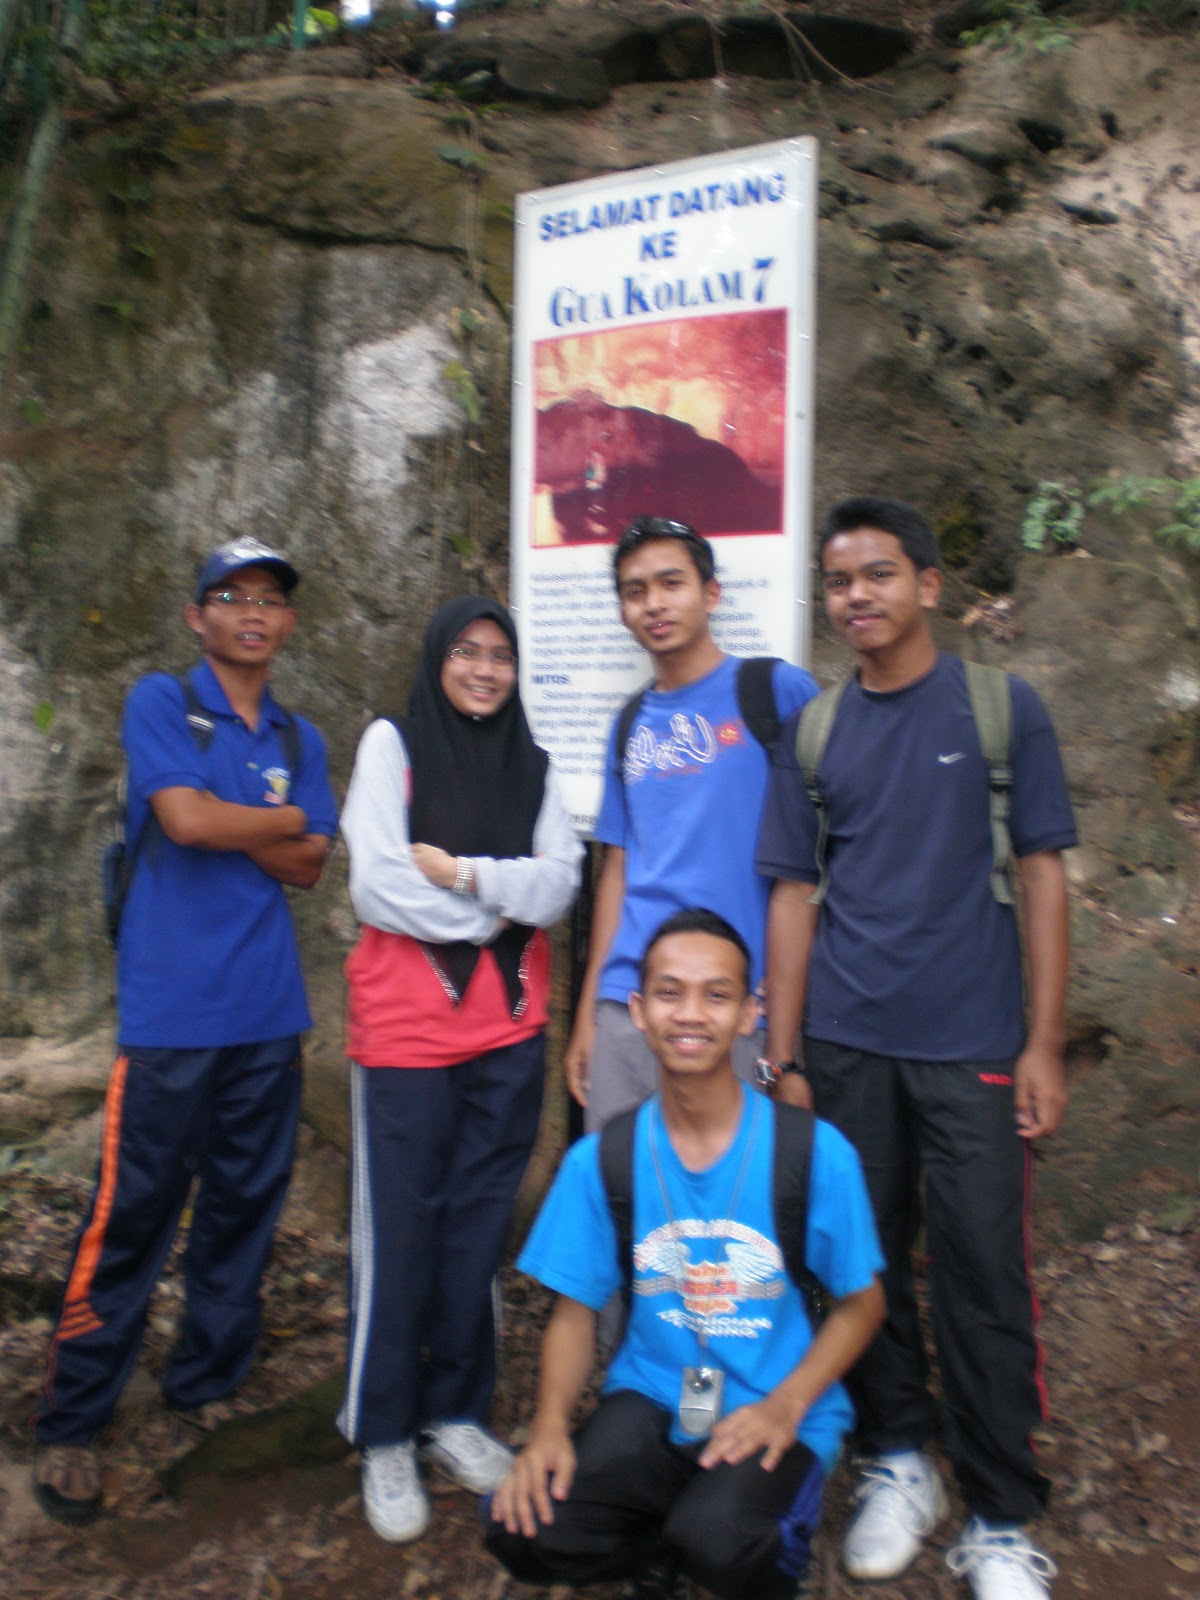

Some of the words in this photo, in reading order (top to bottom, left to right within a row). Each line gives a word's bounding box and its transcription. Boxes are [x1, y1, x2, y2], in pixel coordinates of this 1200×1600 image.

[538, 194, 662, 242] SELAMAT
[668, 171, 788, 218] DATANG
[639, 230, 678, 262] KE
[751, 256, 776, 304] 7
